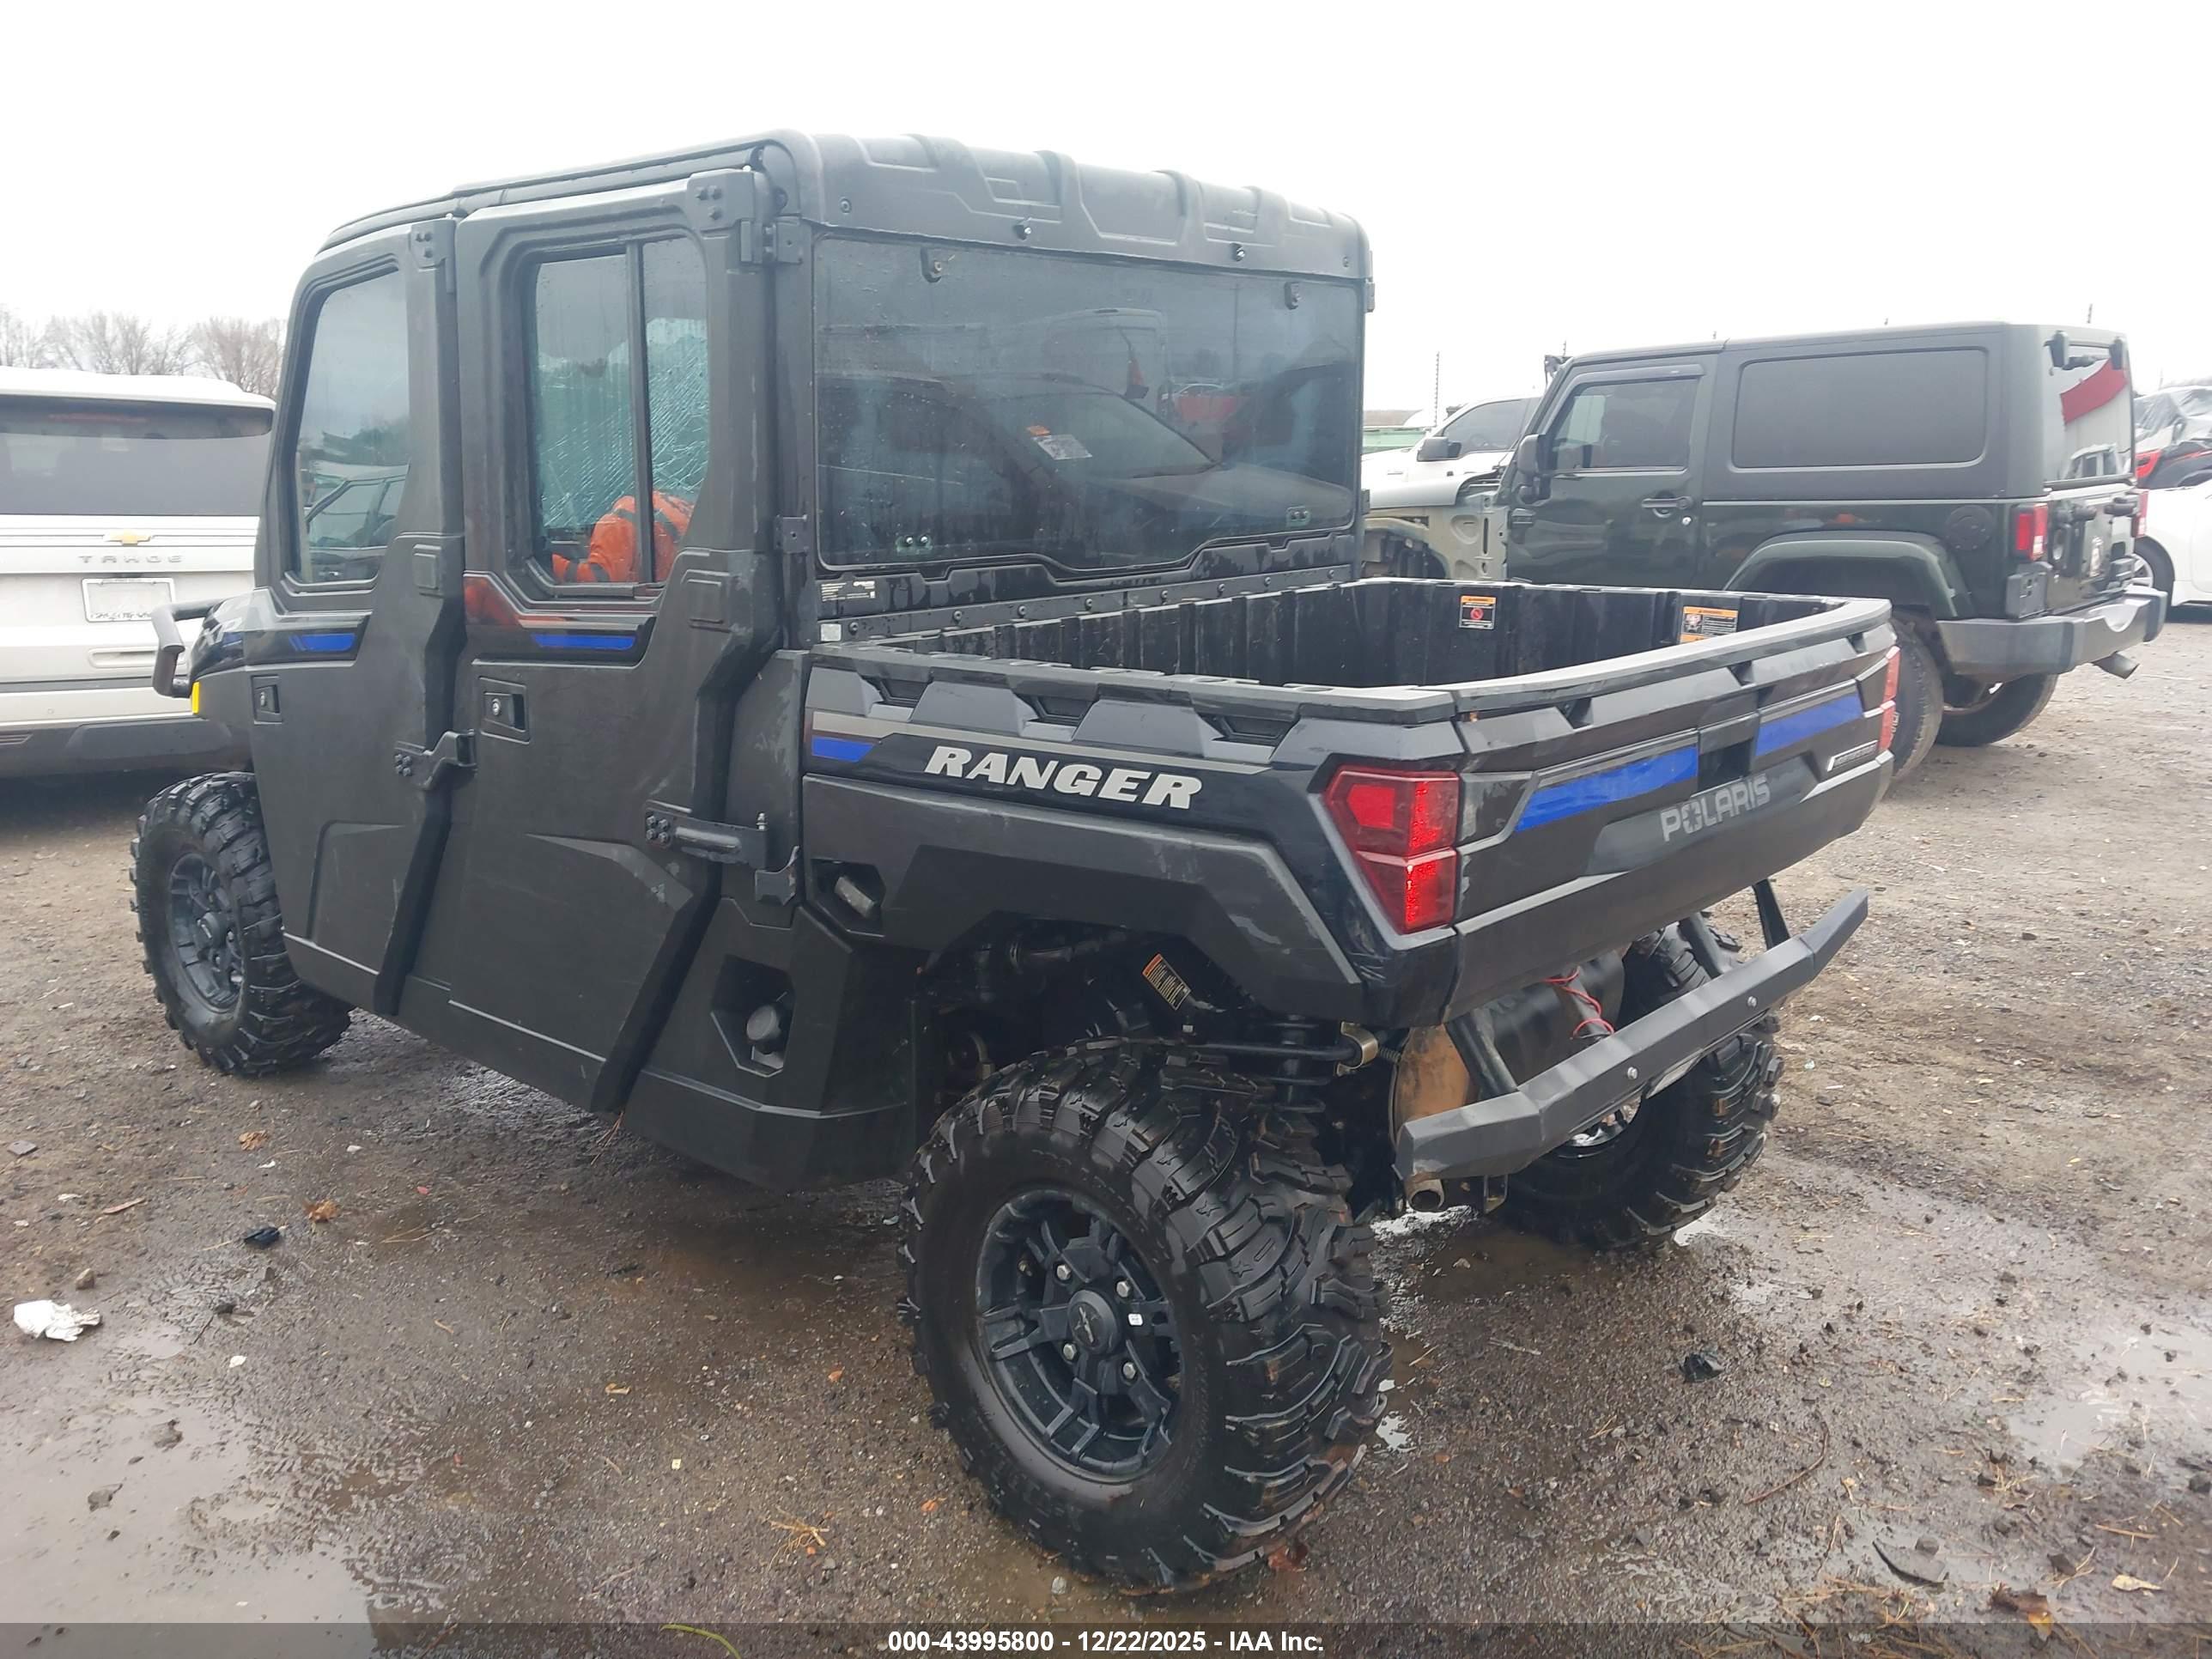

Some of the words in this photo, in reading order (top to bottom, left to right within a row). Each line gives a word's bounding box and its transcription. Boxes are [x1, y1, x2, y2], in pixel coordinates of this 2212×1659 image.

[78, 555, 183, 564] TAHOE
[924, 745, 1203, 810] RANGER
[1660, 773, 1771, 842] POLARIS
